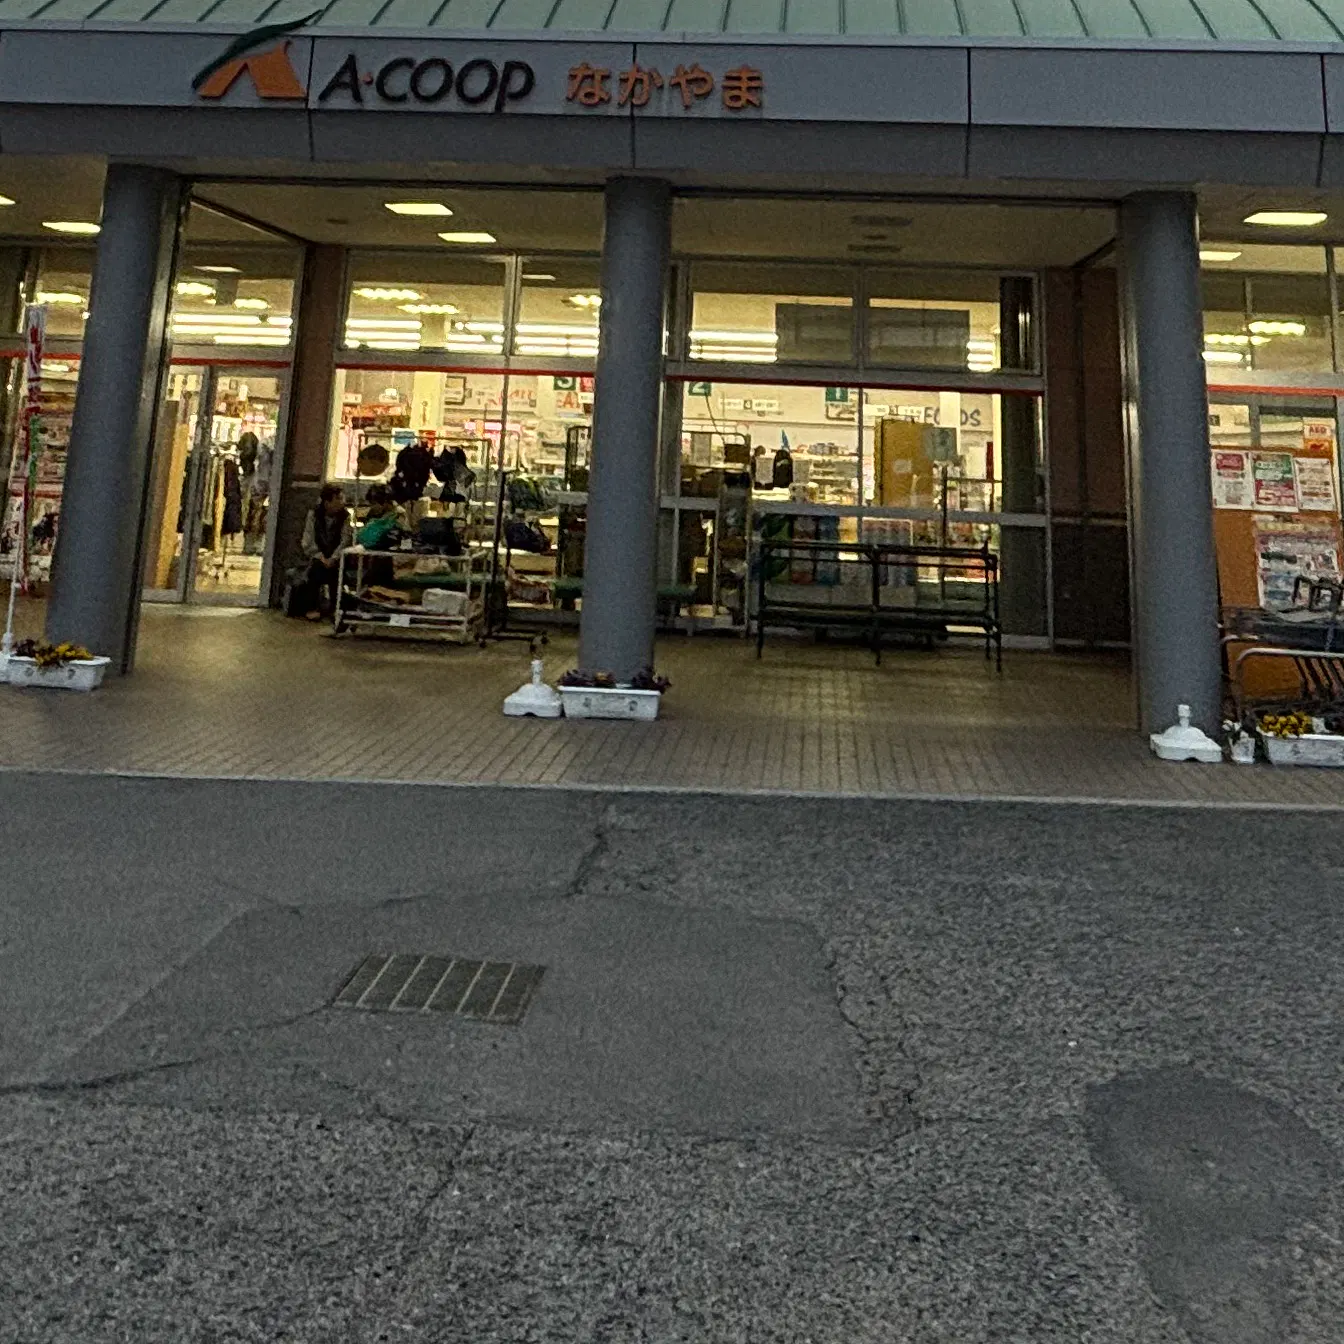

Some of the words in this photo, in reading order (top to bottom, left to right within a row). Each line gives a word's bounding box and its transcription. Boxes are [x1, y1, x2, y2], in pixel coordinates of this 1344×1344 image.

[566, 61, 764, 110] なかやま
[924, 406, 980, 427] FDS
